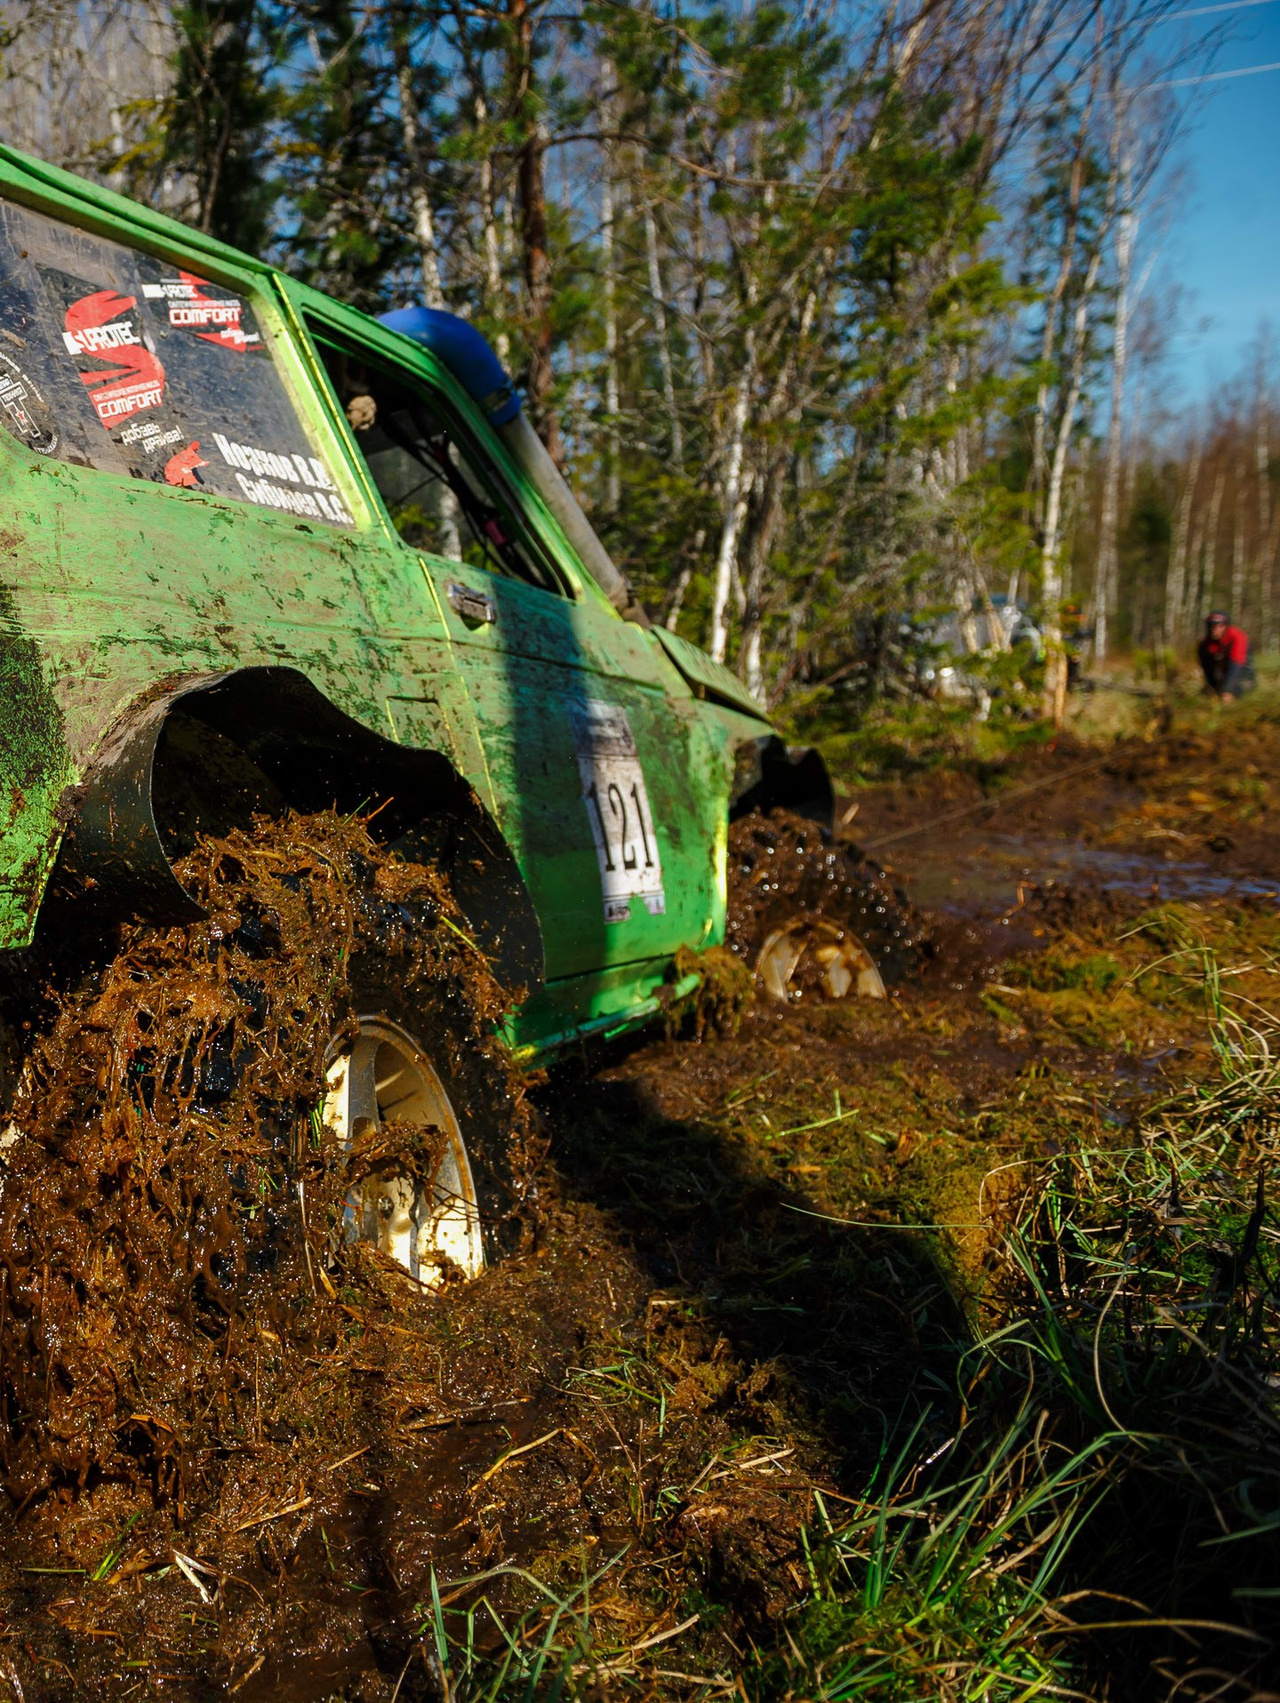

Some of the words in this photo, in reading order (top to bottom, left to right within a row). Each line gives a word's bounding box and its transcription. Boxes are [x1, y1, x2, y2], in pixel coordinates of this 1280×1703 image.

[170, 307, 241, 324] COMFORT
[98, 389, 162, 418] COMFORT
[120, 423, 161, 446] добавь
[588, 781, 654, 872] 121
